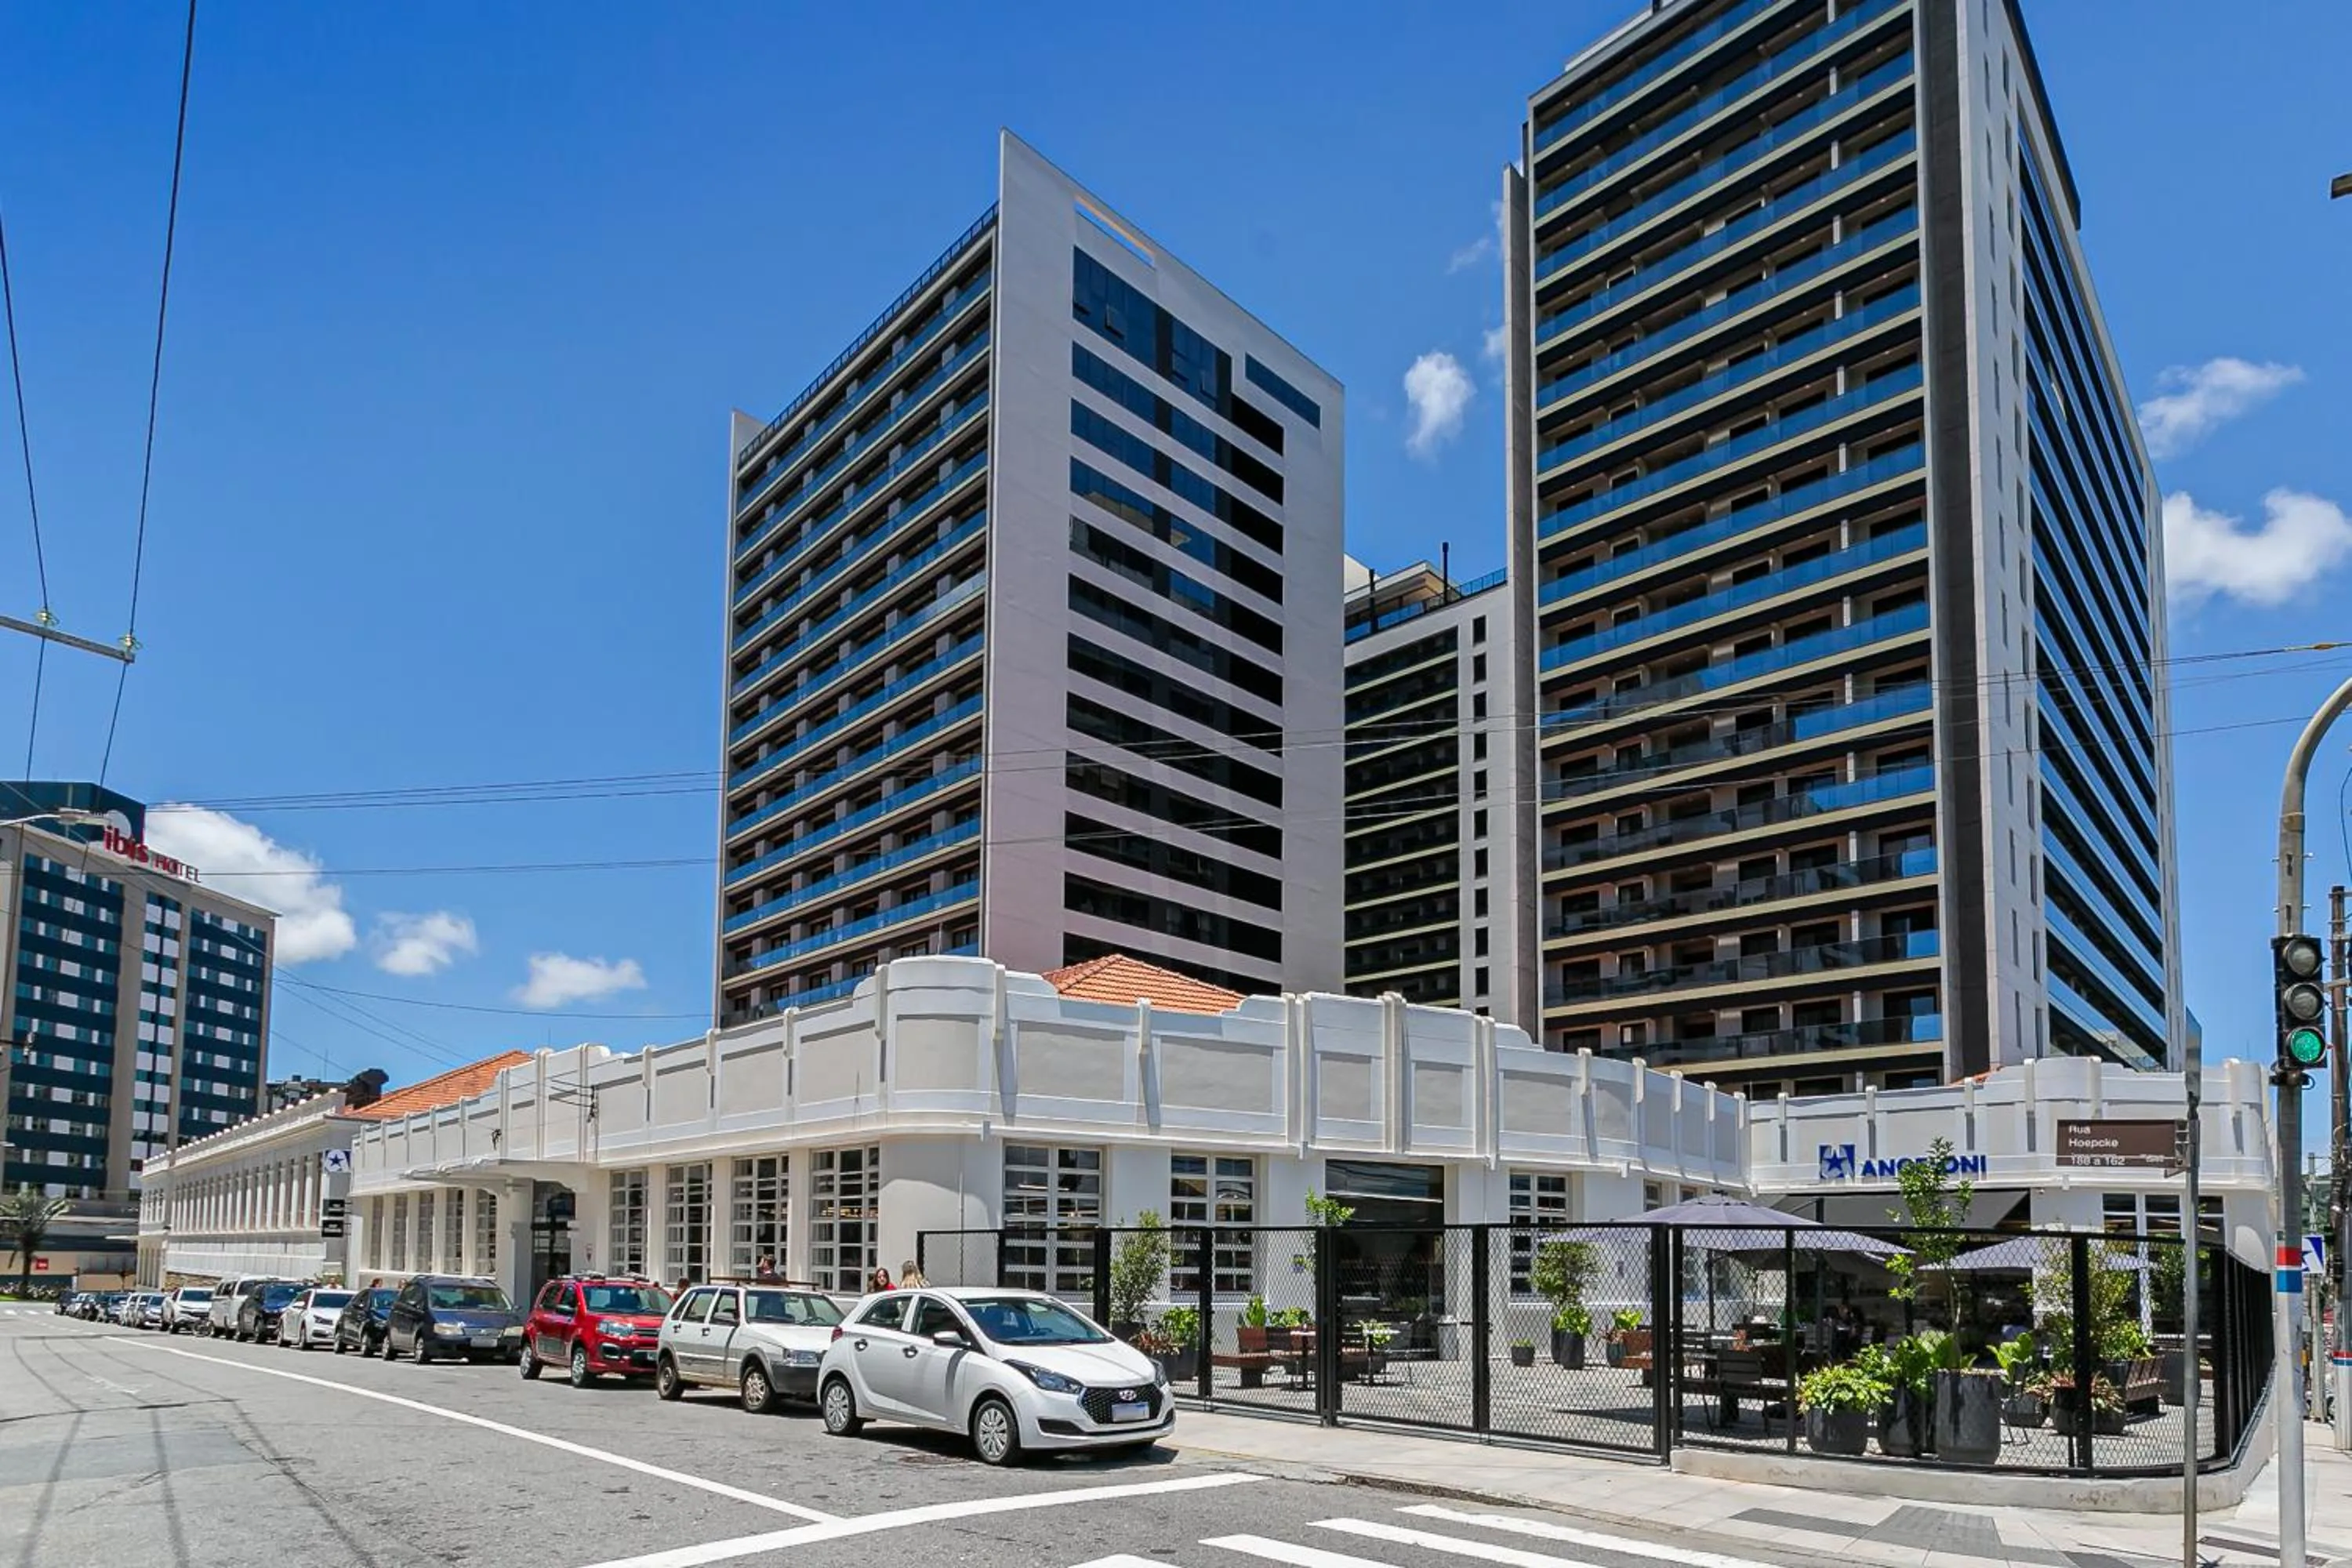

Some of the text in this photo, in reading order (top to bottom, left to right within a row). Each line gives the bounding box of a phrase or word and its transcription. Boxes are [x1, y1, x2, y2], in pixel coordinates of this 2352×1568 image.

[103, 825, 201, 884] ibis HOTEL
[2069, 1125, 2091, 1134] Rua
[2069, 1138, 2119, 1149] Hoepcke
[1861, 1155, 1987, 1176] ANONI
